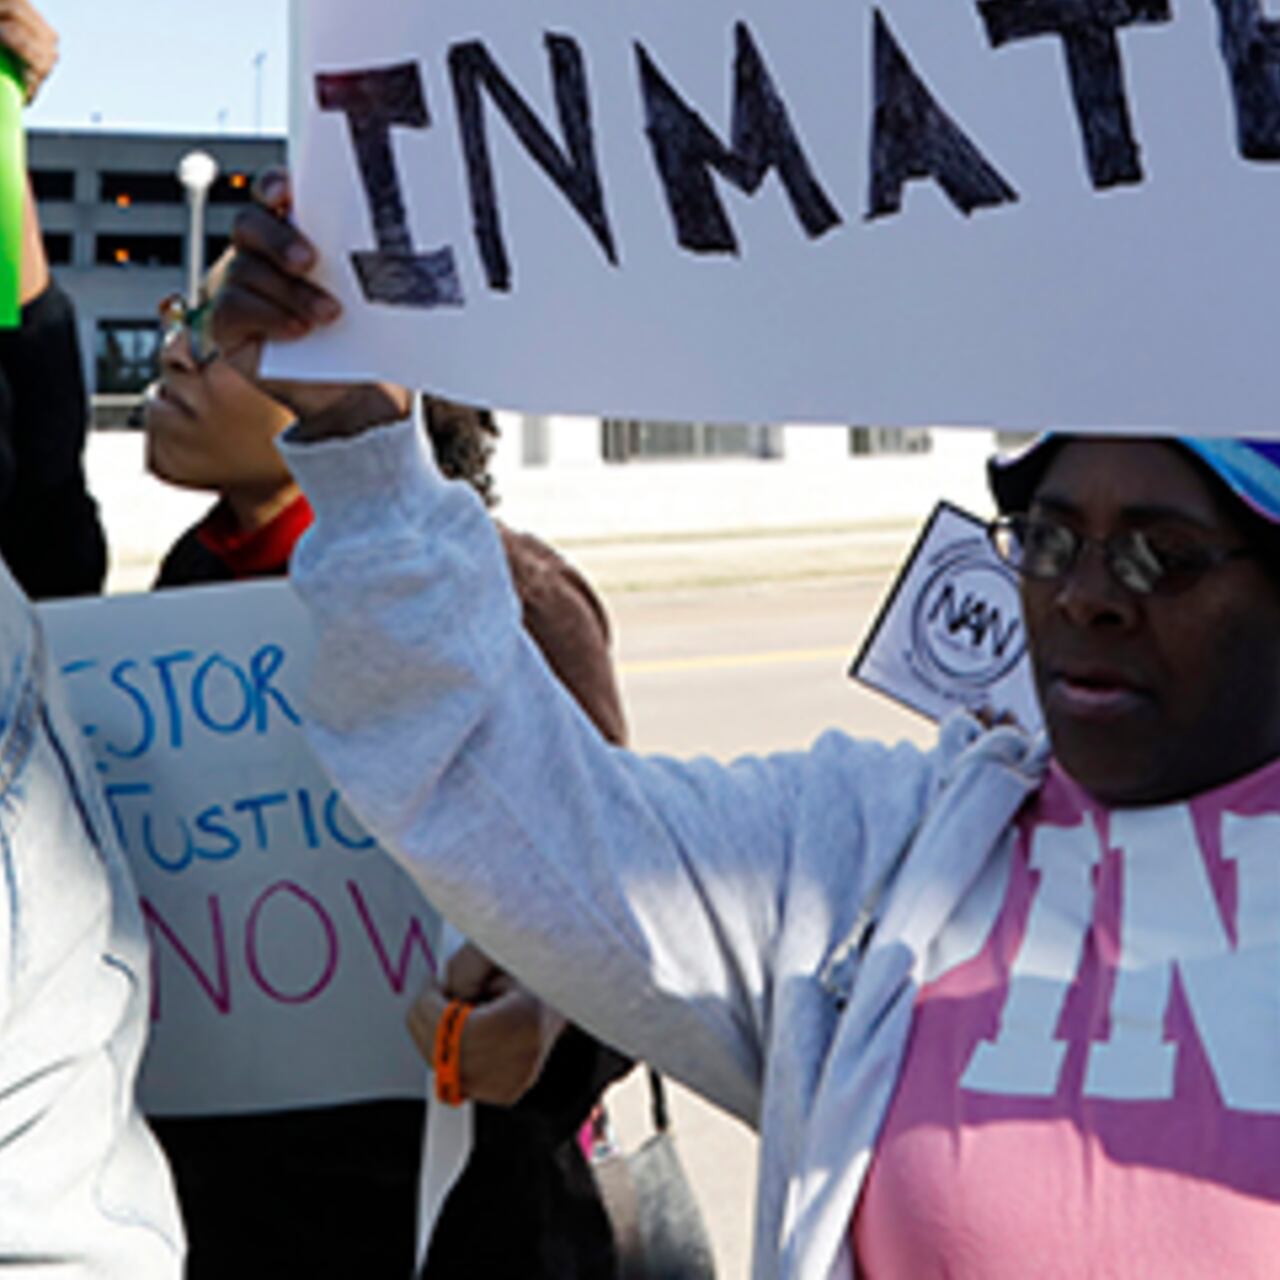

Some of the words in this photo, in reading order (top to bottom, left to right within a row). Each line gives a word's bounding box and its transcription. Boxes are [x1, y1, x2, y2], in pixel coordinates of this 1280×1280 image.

[927, 583, 1020, 658] NAN
[59, 643, 302, 773] STOR
[104, 782, 376, 873] JUSTIC
